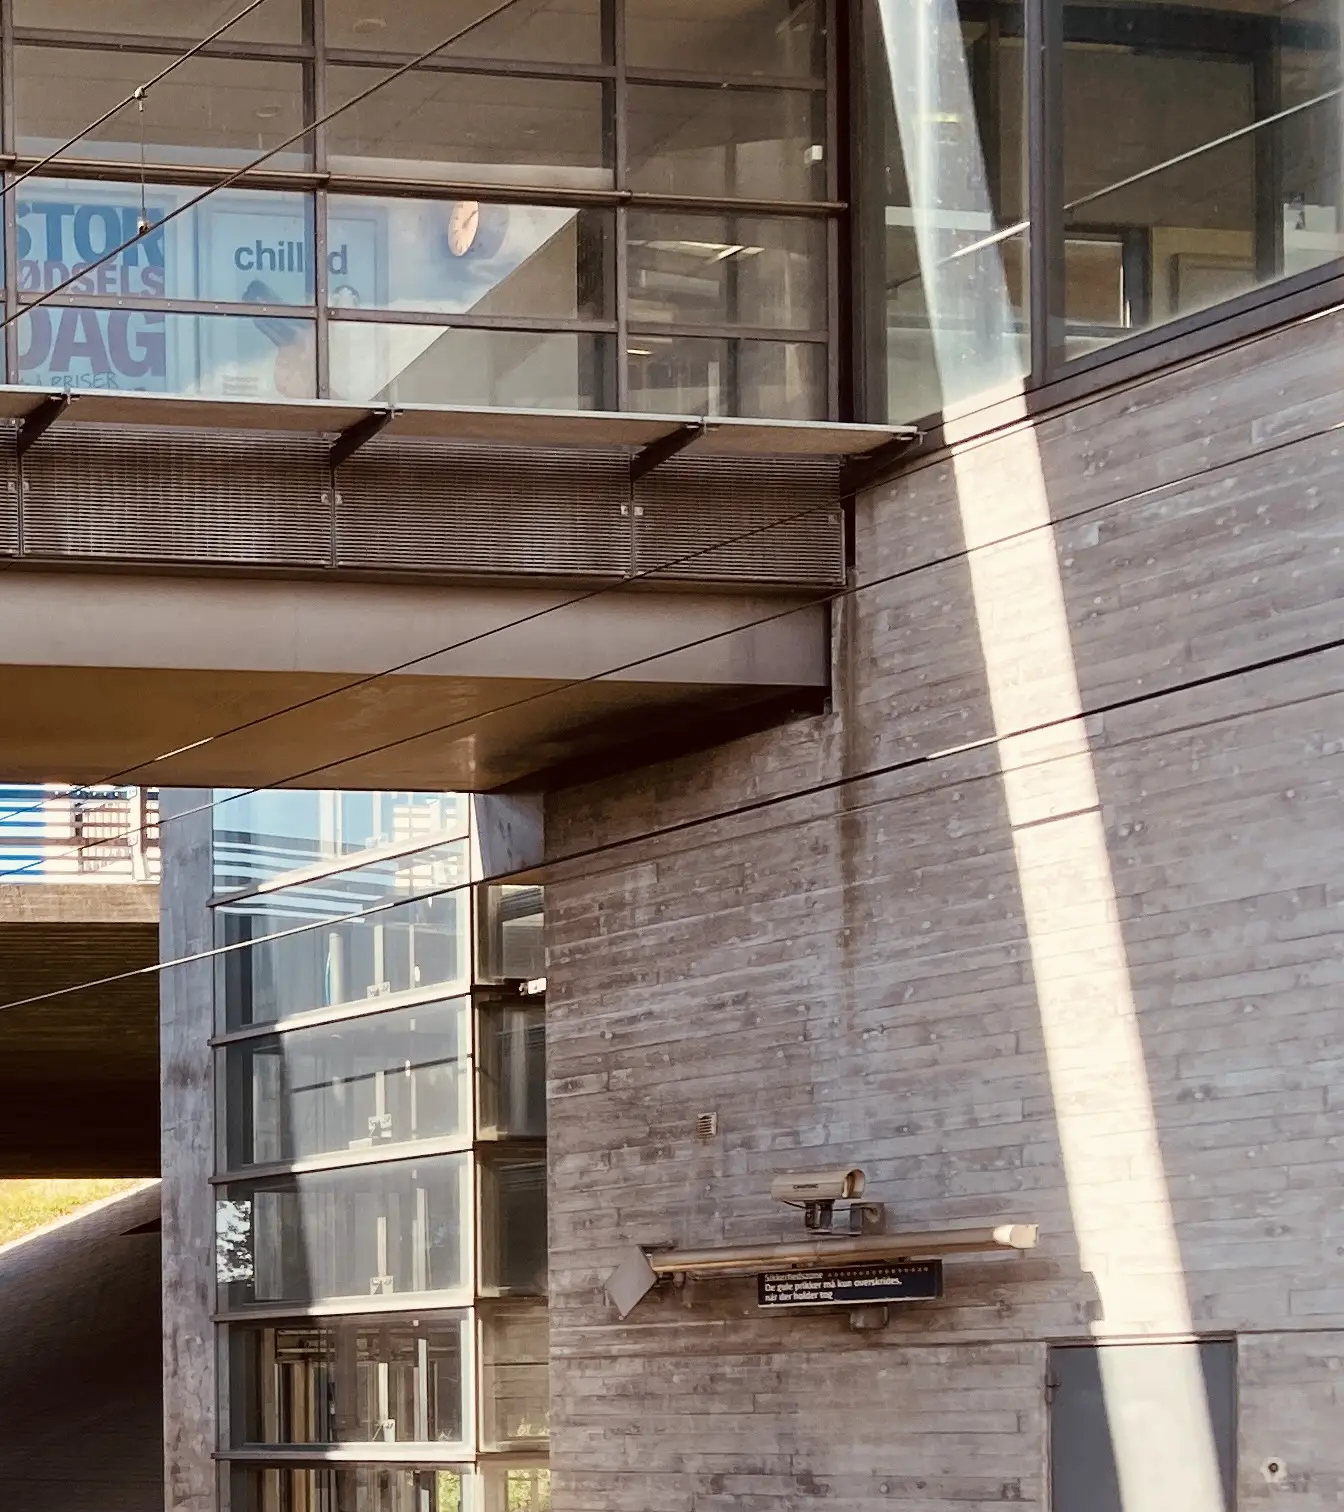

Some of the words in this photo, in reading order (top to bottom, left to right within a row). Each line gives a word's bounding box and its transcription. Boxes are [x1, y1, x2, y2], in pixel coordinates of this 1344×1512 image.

[234, 239, 348, 275] chilld
[18, 260, 165, 297] ØDSELS
[51, 372, 119, 390] PRISER
